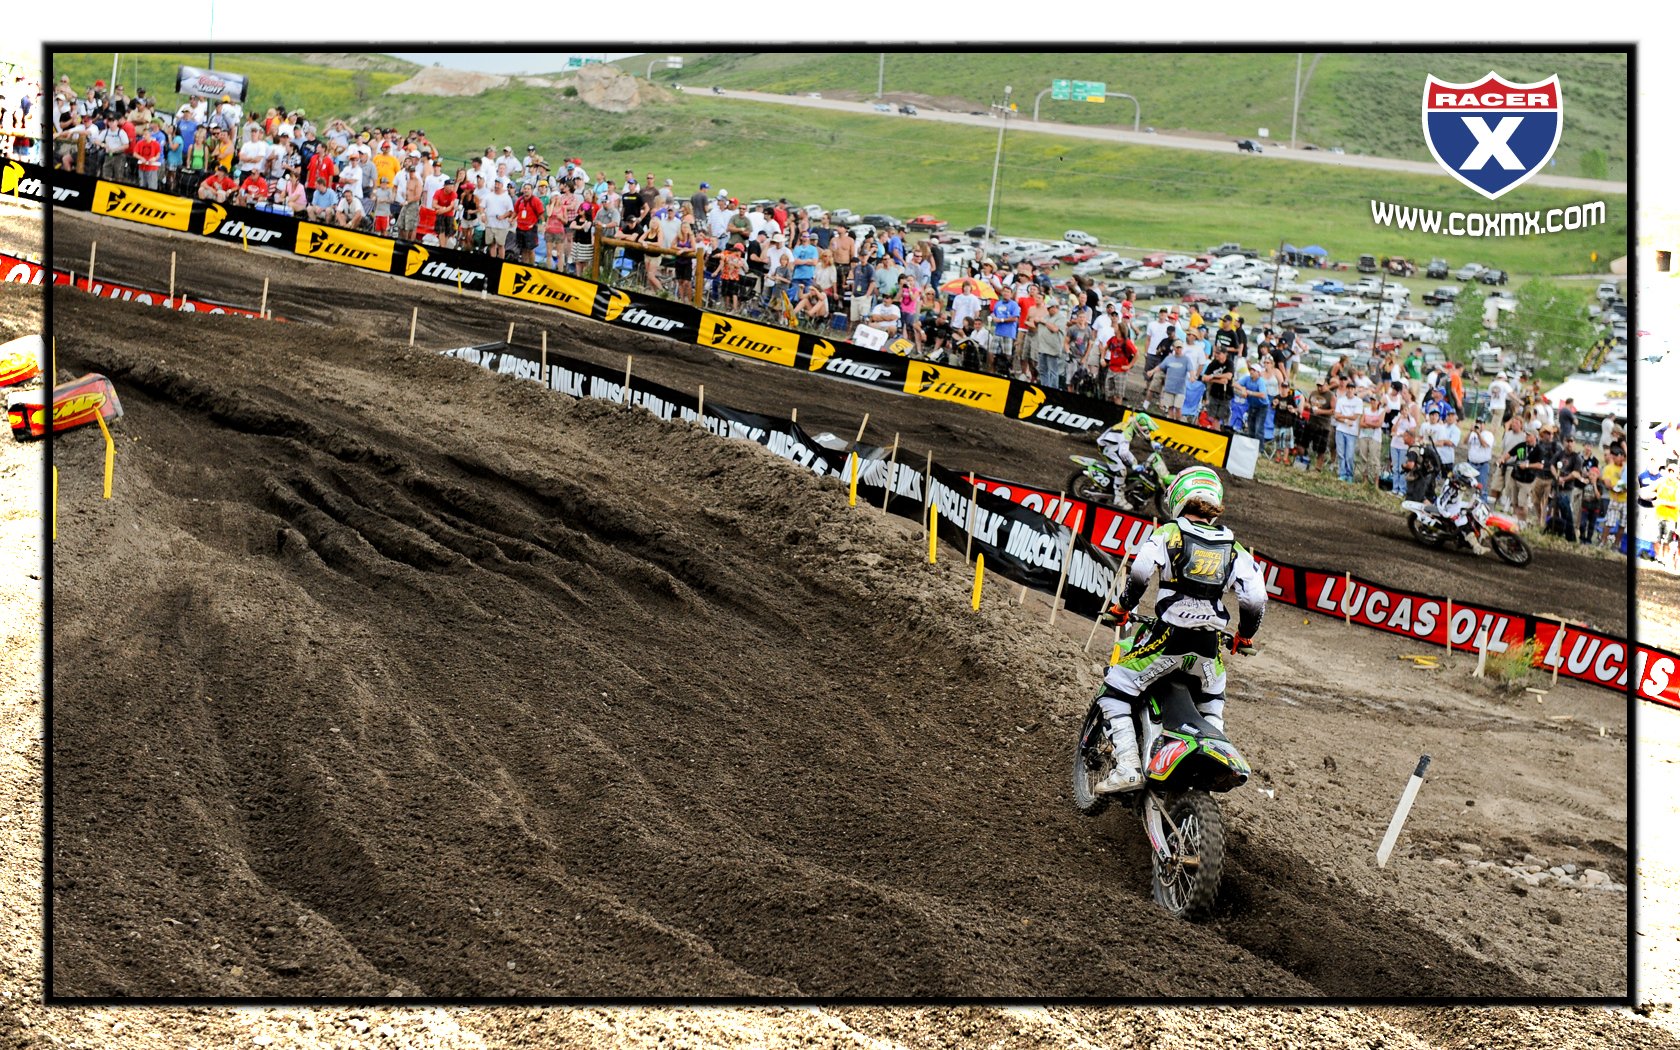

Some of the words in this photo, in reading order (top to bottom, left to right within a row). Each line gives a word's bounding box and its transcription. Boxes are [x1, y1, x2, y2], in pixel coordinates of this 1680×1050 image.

[121, 201, 175, 219] thor
[220, 219, 281, 243] thor
[323, 240, 378, 261] thor
[422, 260, 485, 284] thor
[526, 283, 579, 304] thor
[621, 306, 684, 332] thor
[727, 335, 782, 355] thor
[551, 365, 585, 398] MILK
[826, 357, 891, 382] thor
[933, 382, 992, 402] thor
[1036, 404, 1103, 431] thor
[1094, 472, 1111, 488] 28
[1317, 577, 1441, 637] LUCAS
[1451, 608, 1510, 653] OIL
[1133, 656, 1178, 689] Kawasaki
